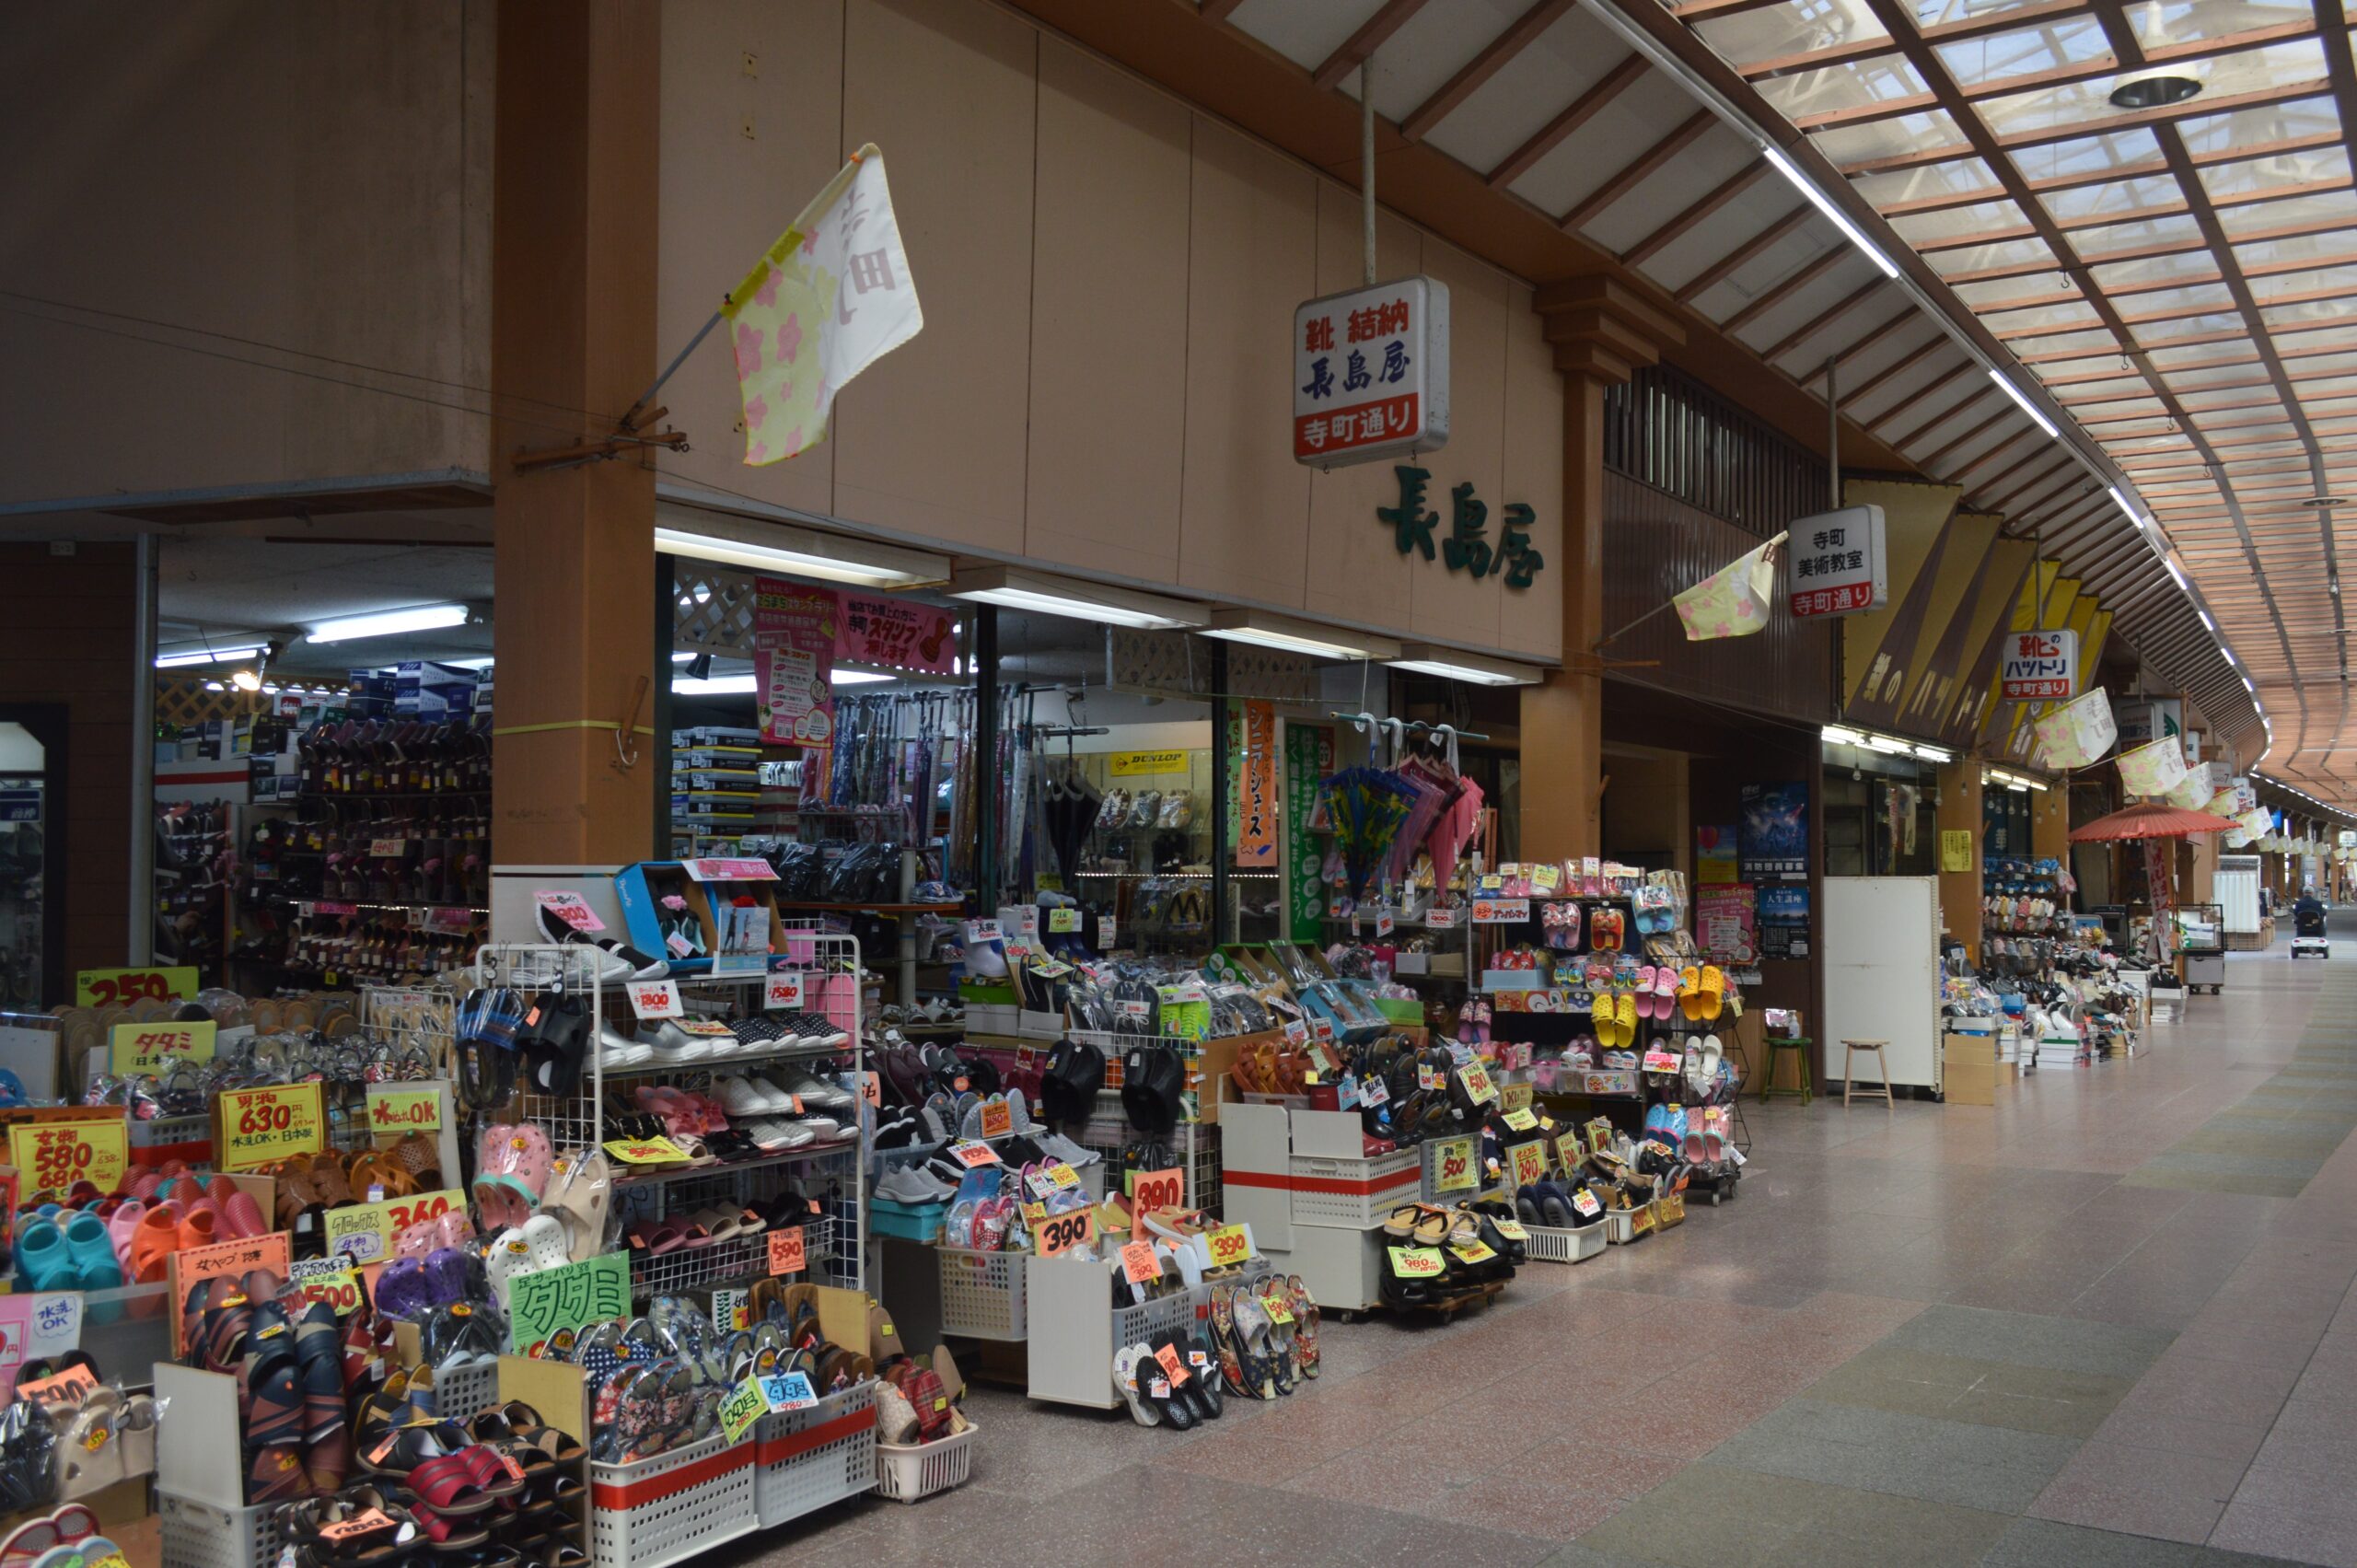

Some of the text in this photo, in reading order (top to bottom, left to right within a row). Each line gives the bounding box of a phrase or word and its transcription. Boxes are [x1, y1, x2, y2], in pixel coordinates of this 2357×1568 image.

[1306, 298, 1409, 354] 靴 結納
[1302, 340, 1411, 400] 長島屋
[1304, 401, 1410, 448] 寺町通り
[1376, 465, 1544, 588] 長島屋
[1813, 528, 1845, 550] 寺町
[1798, 550, 1864, 578] 美術教室
[848, 601, 918, 622] 当店でお買上の方に
[1795, 587, 1870, 614] 寺町通り
[848, 614, 922, 643] 寺町 スタンプ
[865, 641, 911, 662] 押します
[2007, 681, 2065, 696] 寺町通り
[1132, 753, 1181, 763] DUNLOP
[1249, 707, 1264, 837] シニアシューズ
[1492, 910, 1528, 919] アンパンマン
[978, 921, 996, 933] 長靴
[135, 1033, 192, 1054] タタミ
[237, 1092, 277, 1109] 男物
[33, 1129, 78, 1145] 女物
[35, 1143, 93, 1172] 580
[1443, 1157, 1467, 1179] 500
[38, 1168, 85, 1189] 680
[1137, 1178, 1179, 1221] 390
[332, 1212, 379, 1236] クロックス
[772, 1241, 801, 1260] 590
[304, 1283, 356, 1309] 500
[521, 1270, 621, 1334] タタミ
[38, 1299, 73, 1319] 水洗
[42, 1315, 68, 1330] OK
[769, 1383, 810, 1401] タタミ
